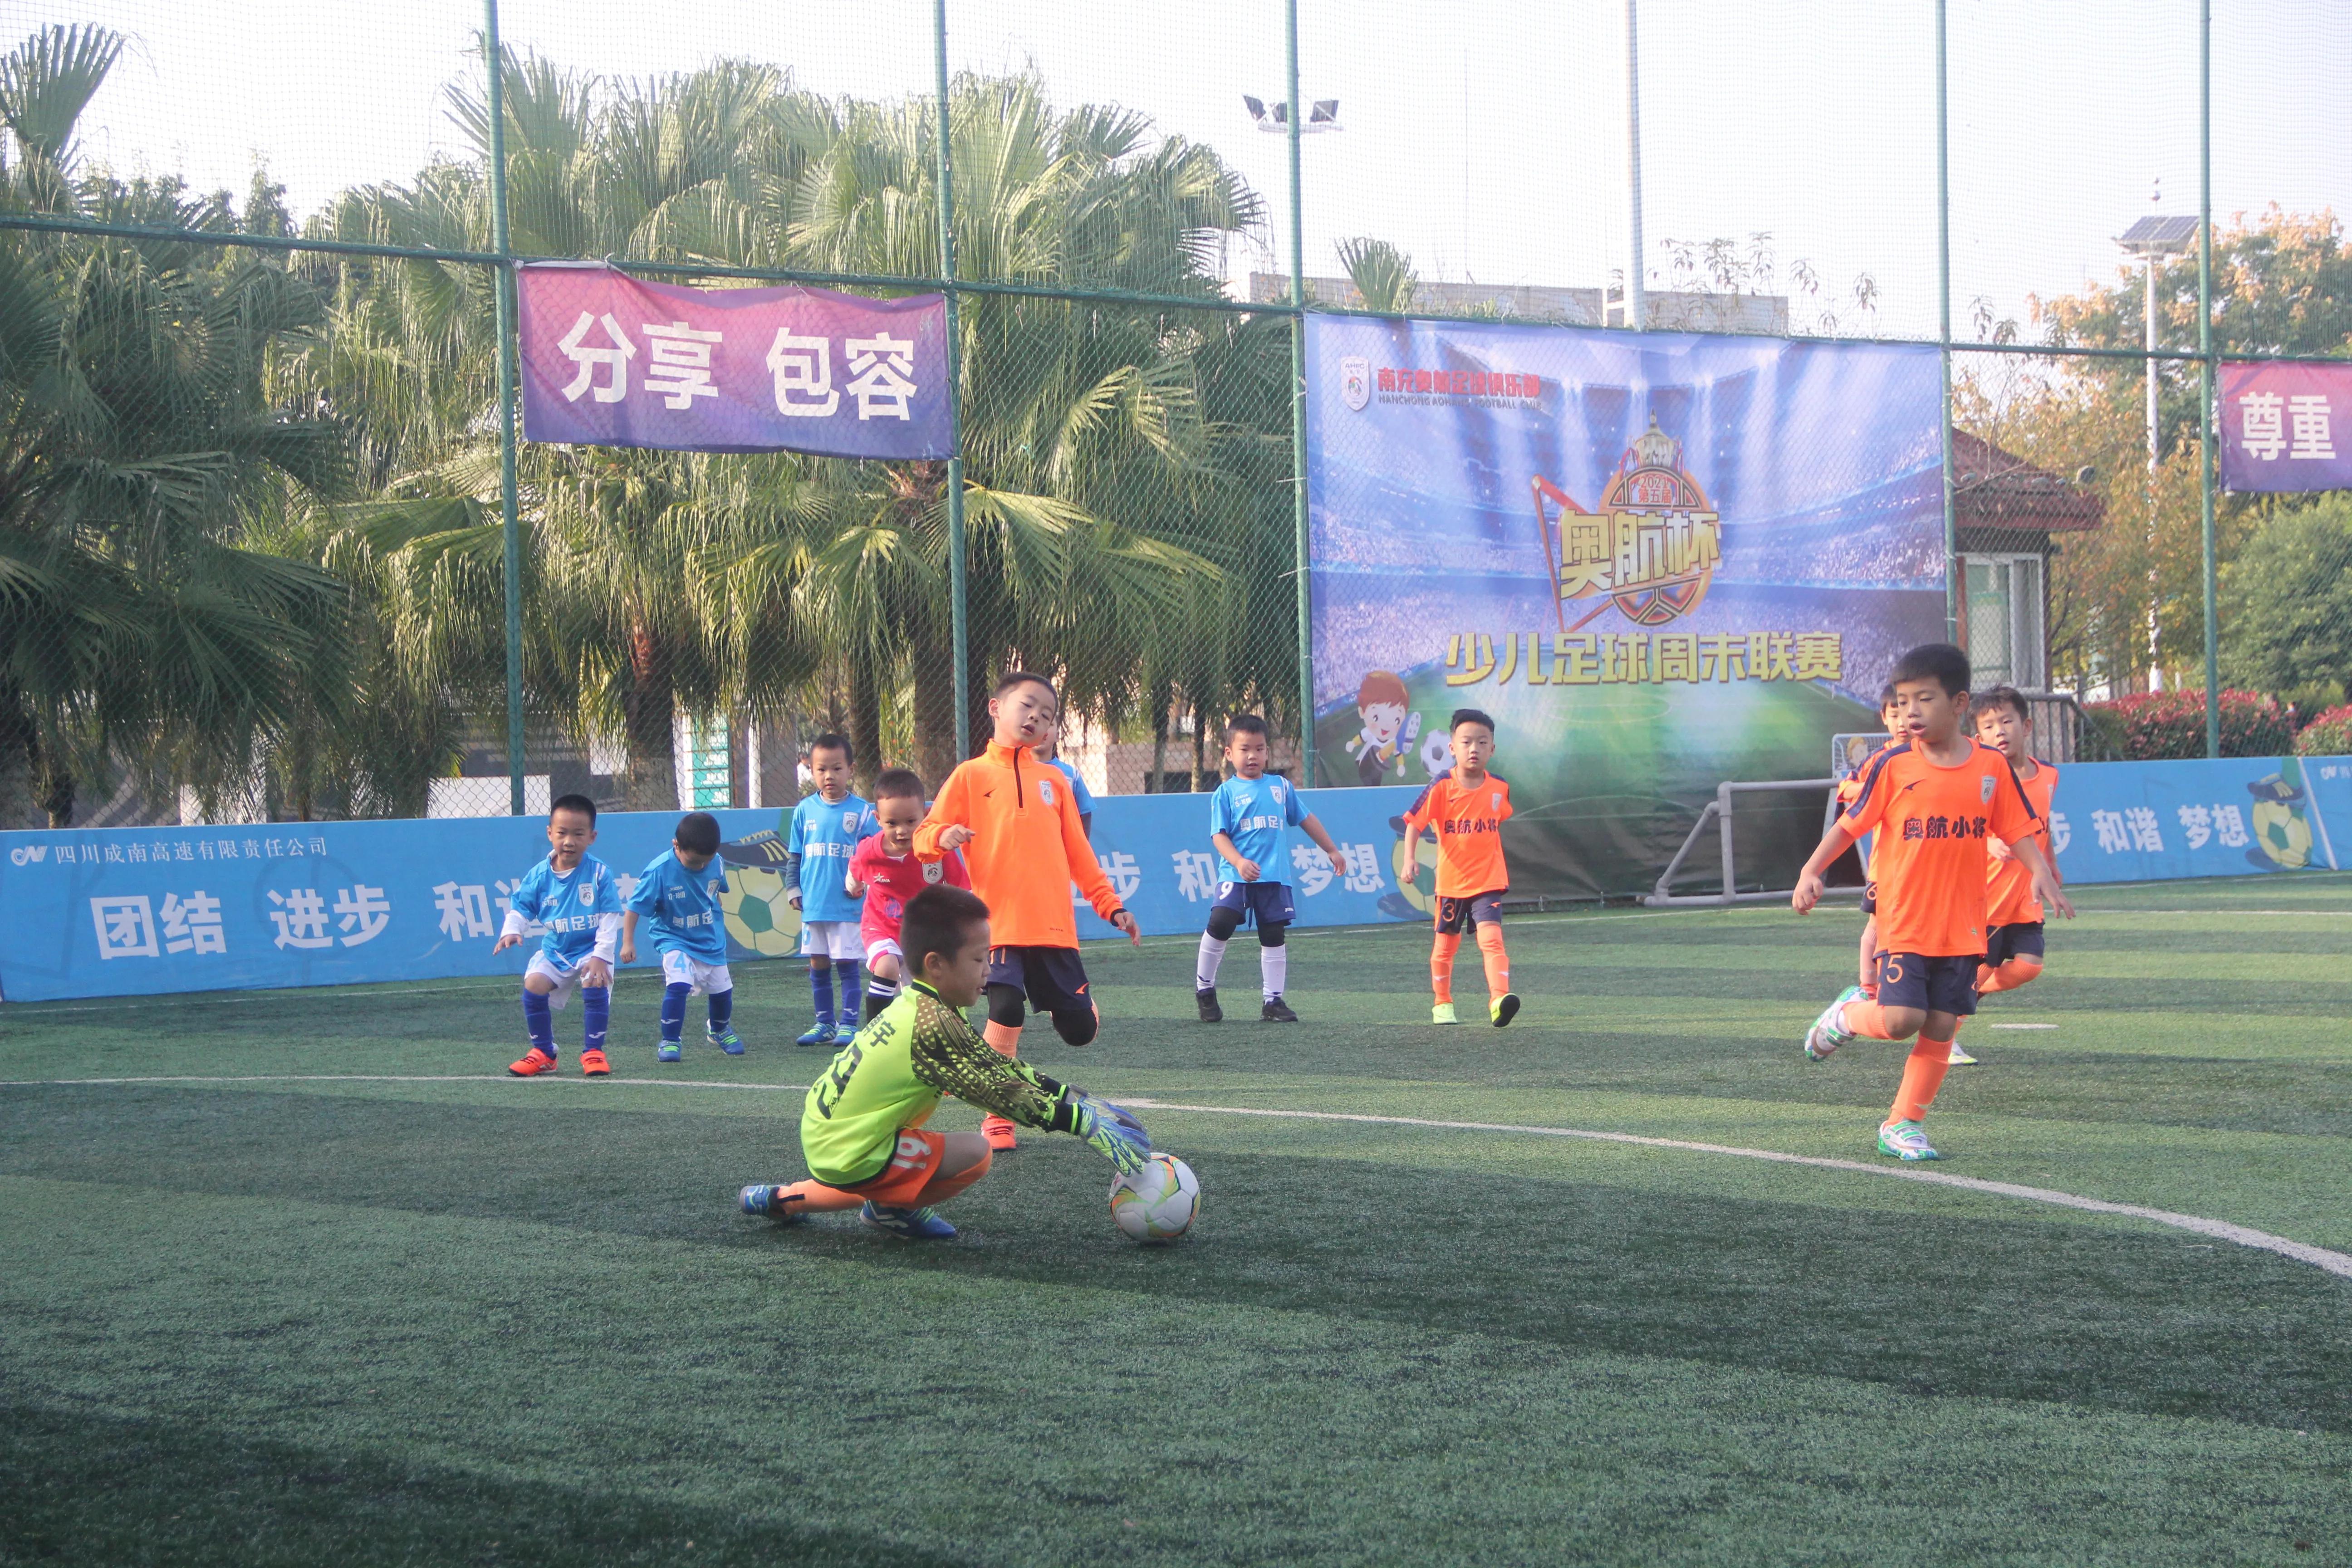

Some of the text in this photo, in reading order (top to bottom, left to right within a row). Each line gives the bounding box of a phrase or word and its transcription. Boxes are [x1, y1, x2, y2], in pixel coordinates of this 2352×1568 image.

[558, 311, 917, 421] 分享 包容
[2239, 392, 2336, 461] 尊重
[1638, 488, 1672, 503] 第五届
[1640, 475, 1667, 488] 2021
[1560, 509, 1721, 600] 奥航杯
[1446, 631, 1842, 686] 少儿足球周末联赛
[1240, 816, 1284, 832] 奥航足
[2091, 807, 2164, 854] 和谐
[2178, 804, 2249, 849] 梦想
[55, 837, 327, 864] 四川成南高速有限责任公司
[1291, 843, 1385, 897] 梦想
[1219, 881, 1234, 900] 9
[90, 891, 227, 960] 团结
[267, 884, 391, 951] 进步
[1443, 902, 1455, 922] 3
[1886, 954, 1903, 984] 5
